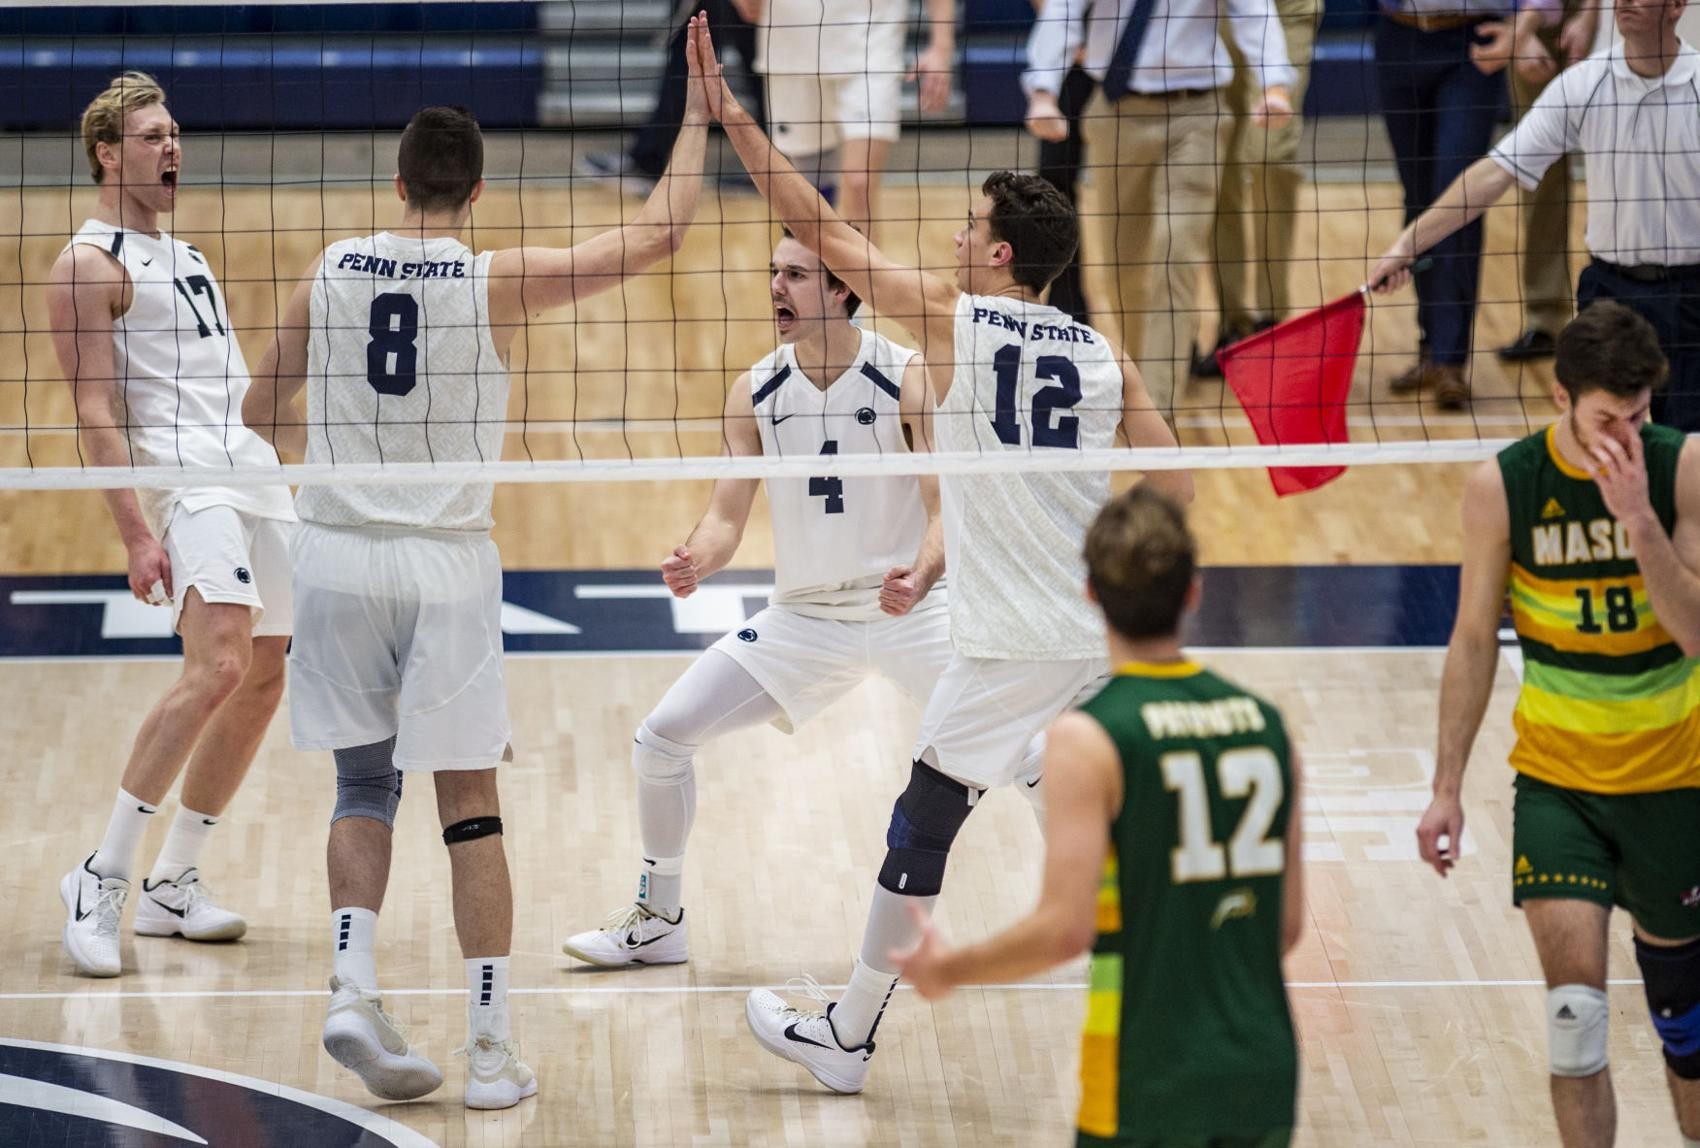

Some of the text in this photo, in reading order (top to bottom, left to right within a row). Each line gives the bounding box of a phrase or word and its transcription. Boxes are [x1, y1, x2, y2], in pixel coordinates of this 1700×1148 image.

[338, 253, 465, 280] PENN STATE
[174, 275, 225, 338] 17
[973, 308, 1095, 345] PENN STATE
[367, 292, 419, 396] 8
[990, 343, 1083, 449] 12
[809, 440, 844, 514] 4
[1575, 586, 1638, 634] 18
[1159, 745, 1284, 884] 12
